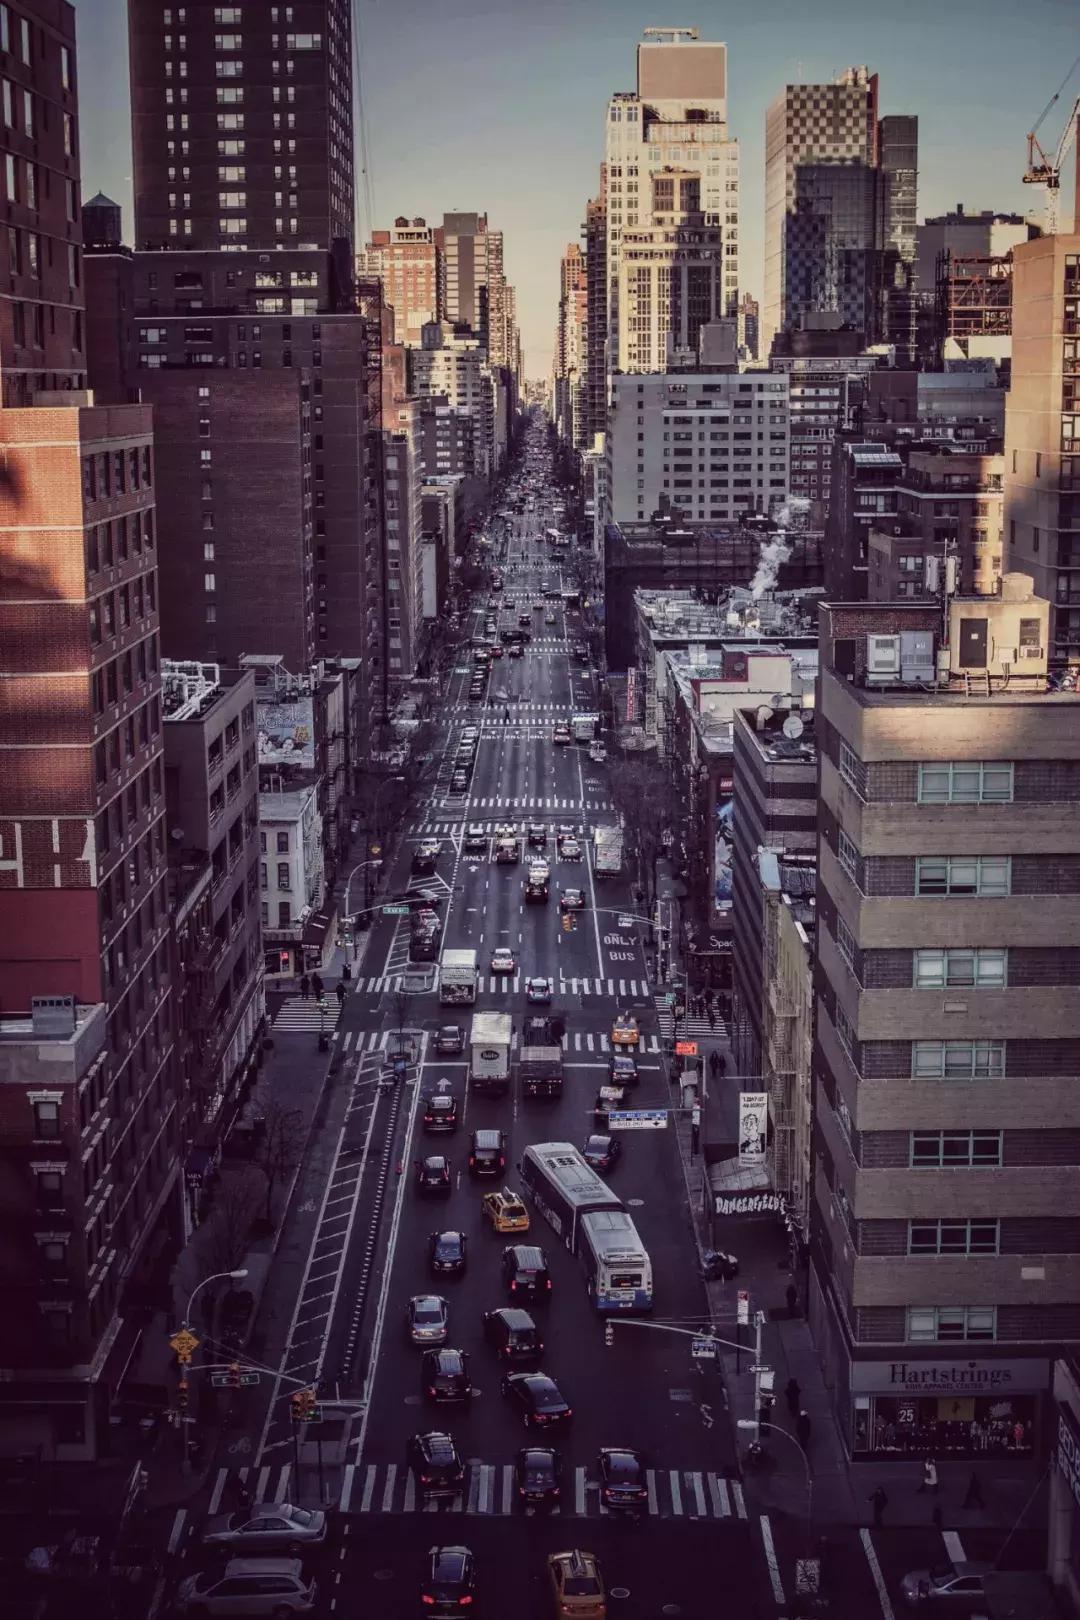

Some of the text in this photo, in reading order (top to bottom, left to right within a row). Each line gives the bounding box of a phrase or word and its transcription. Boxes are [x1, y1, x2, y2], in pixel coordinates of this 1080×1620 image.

[604, 936, 637, 945] ONLY
[609, 952, 635, 961] BUS
[888, 1362, 1012, 1388] Hartstrings
[899, 1409, 914, 1422] 25
